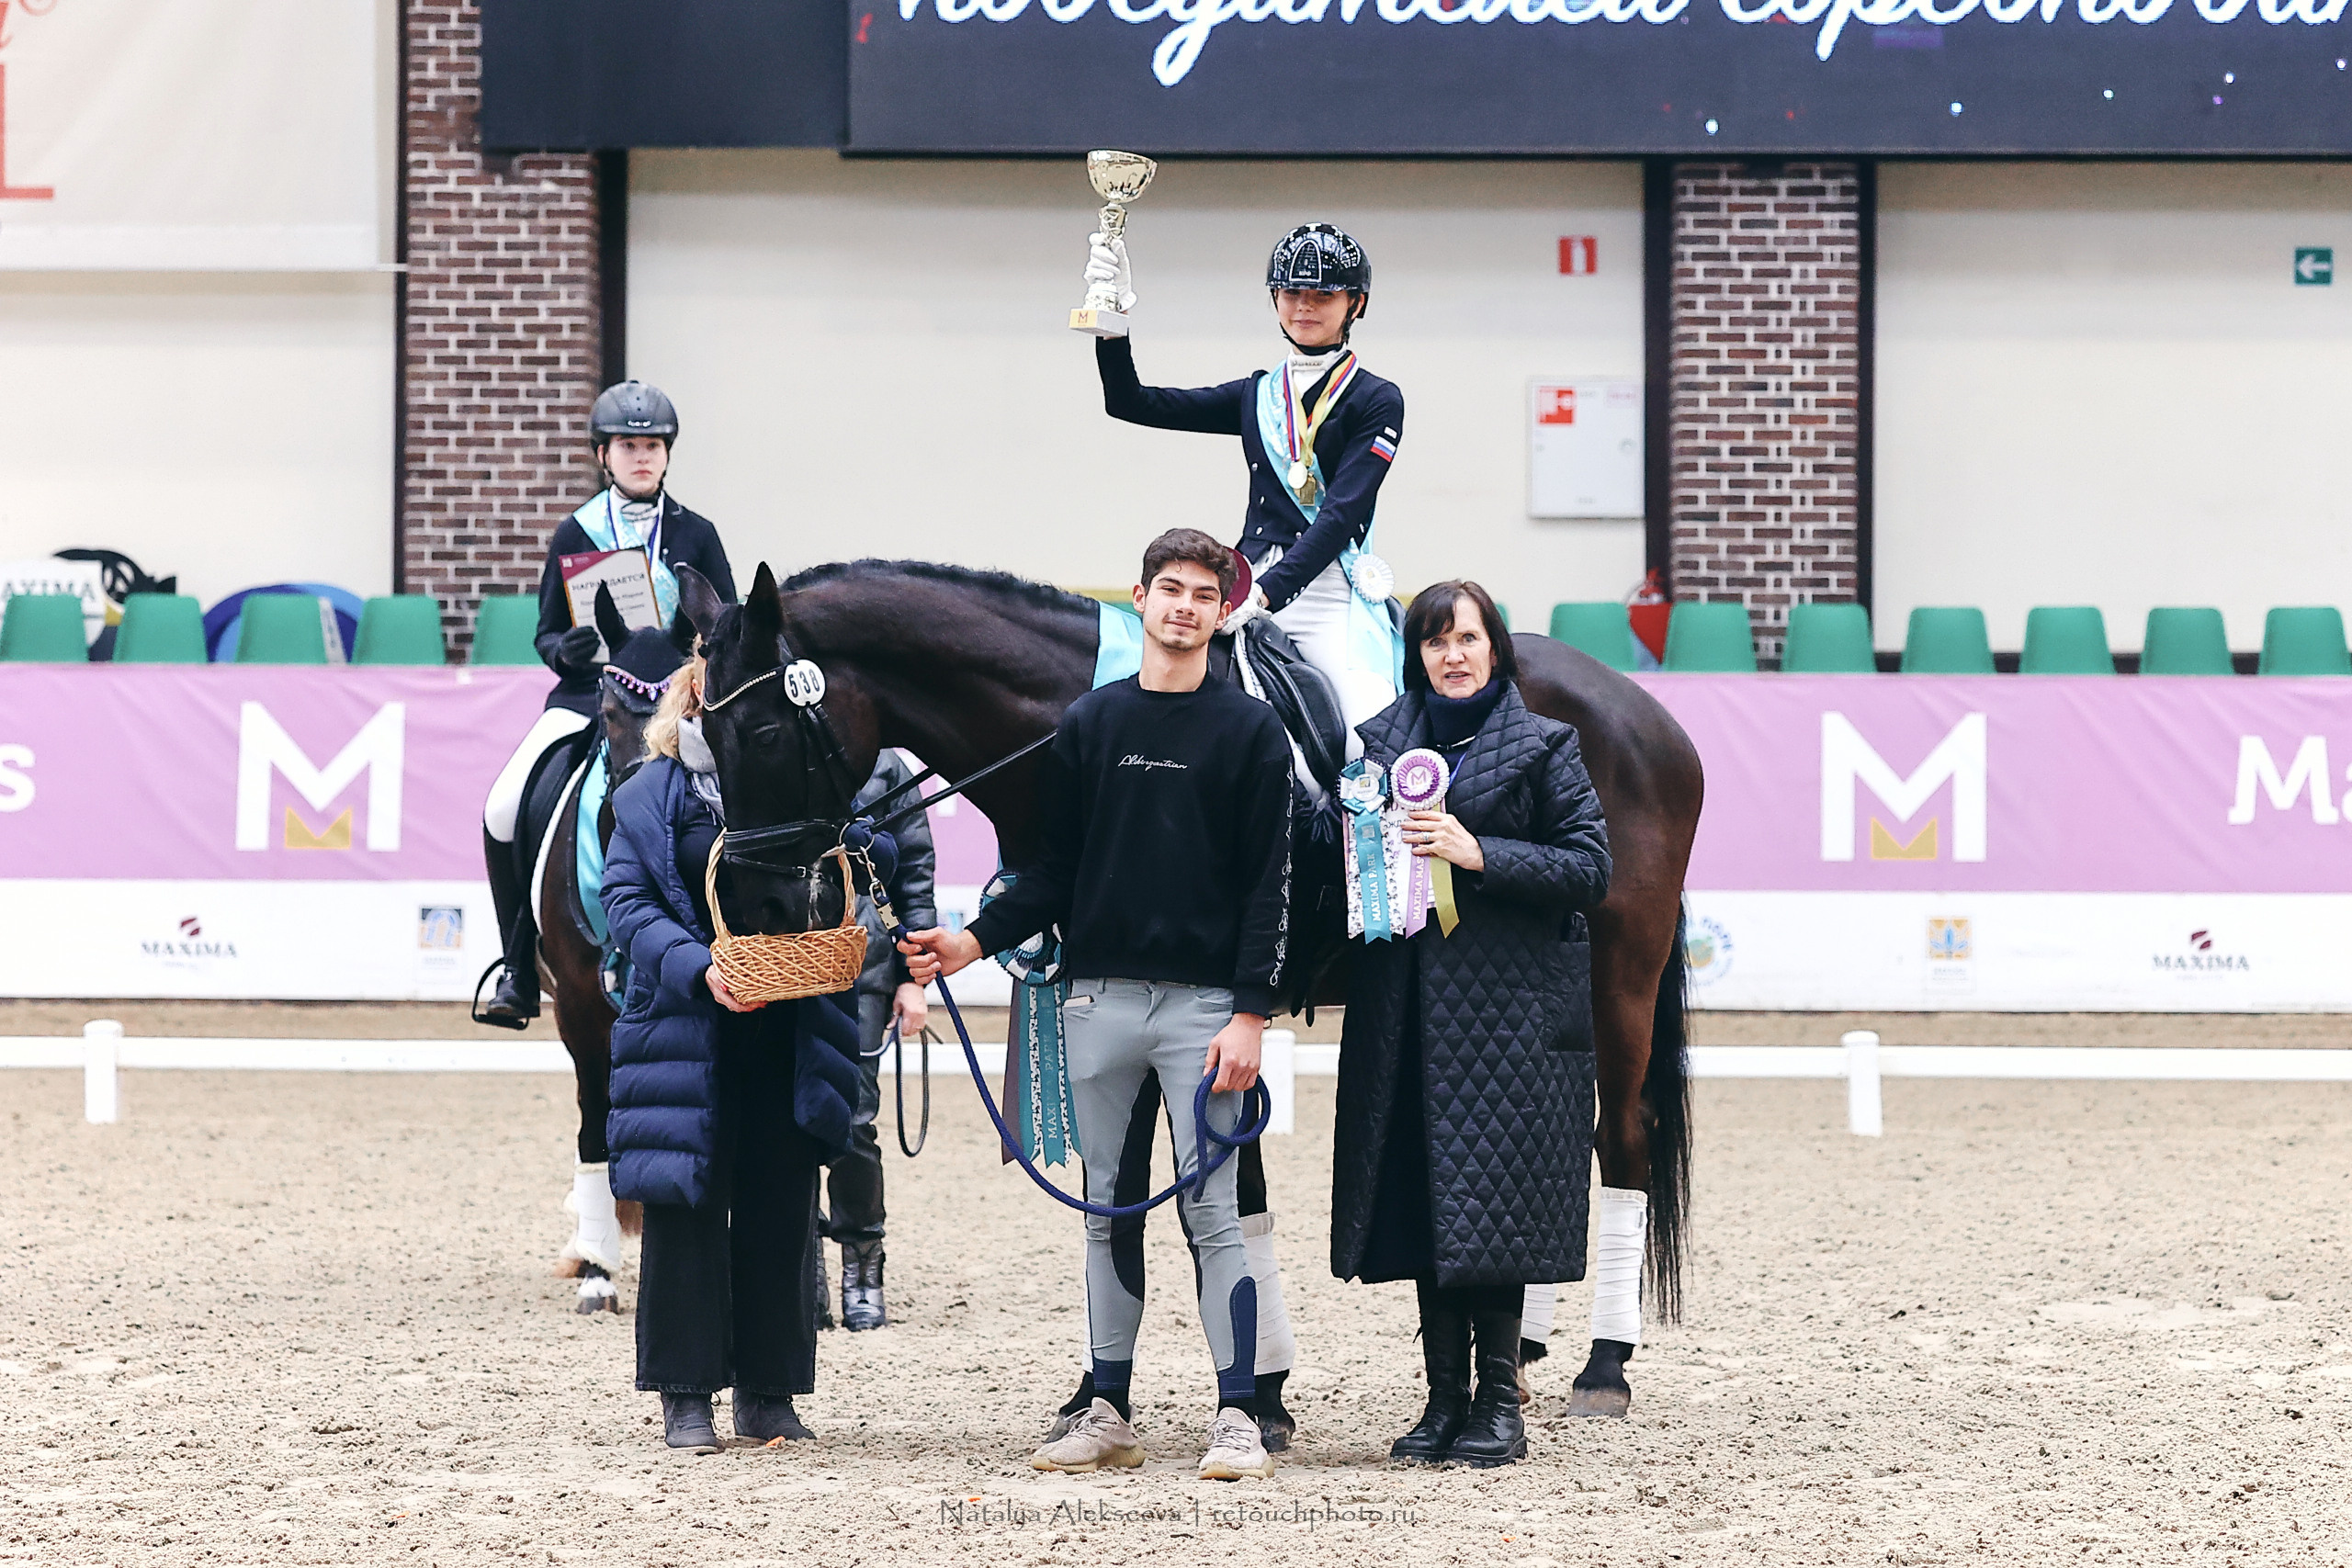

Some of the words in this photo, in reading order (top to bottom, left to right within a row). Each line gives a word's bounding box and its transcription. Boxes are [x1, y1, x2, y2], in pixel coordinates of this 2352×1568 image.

[788, 669, 820, 698] 538
[235, 701, 406, 852] M
[1820, 711, 1987, 863] M
[2227, 734, 2352, 825] M
[1367, 853, 1378, 879] PARK
[1416, 855, 1425, 878] MAS
[1367, 882, 1382, 921] MAXIMA
[1413, 880, 1423, 920] MAXIMA
[2152, 953, 2250, 972] MAXIMA
